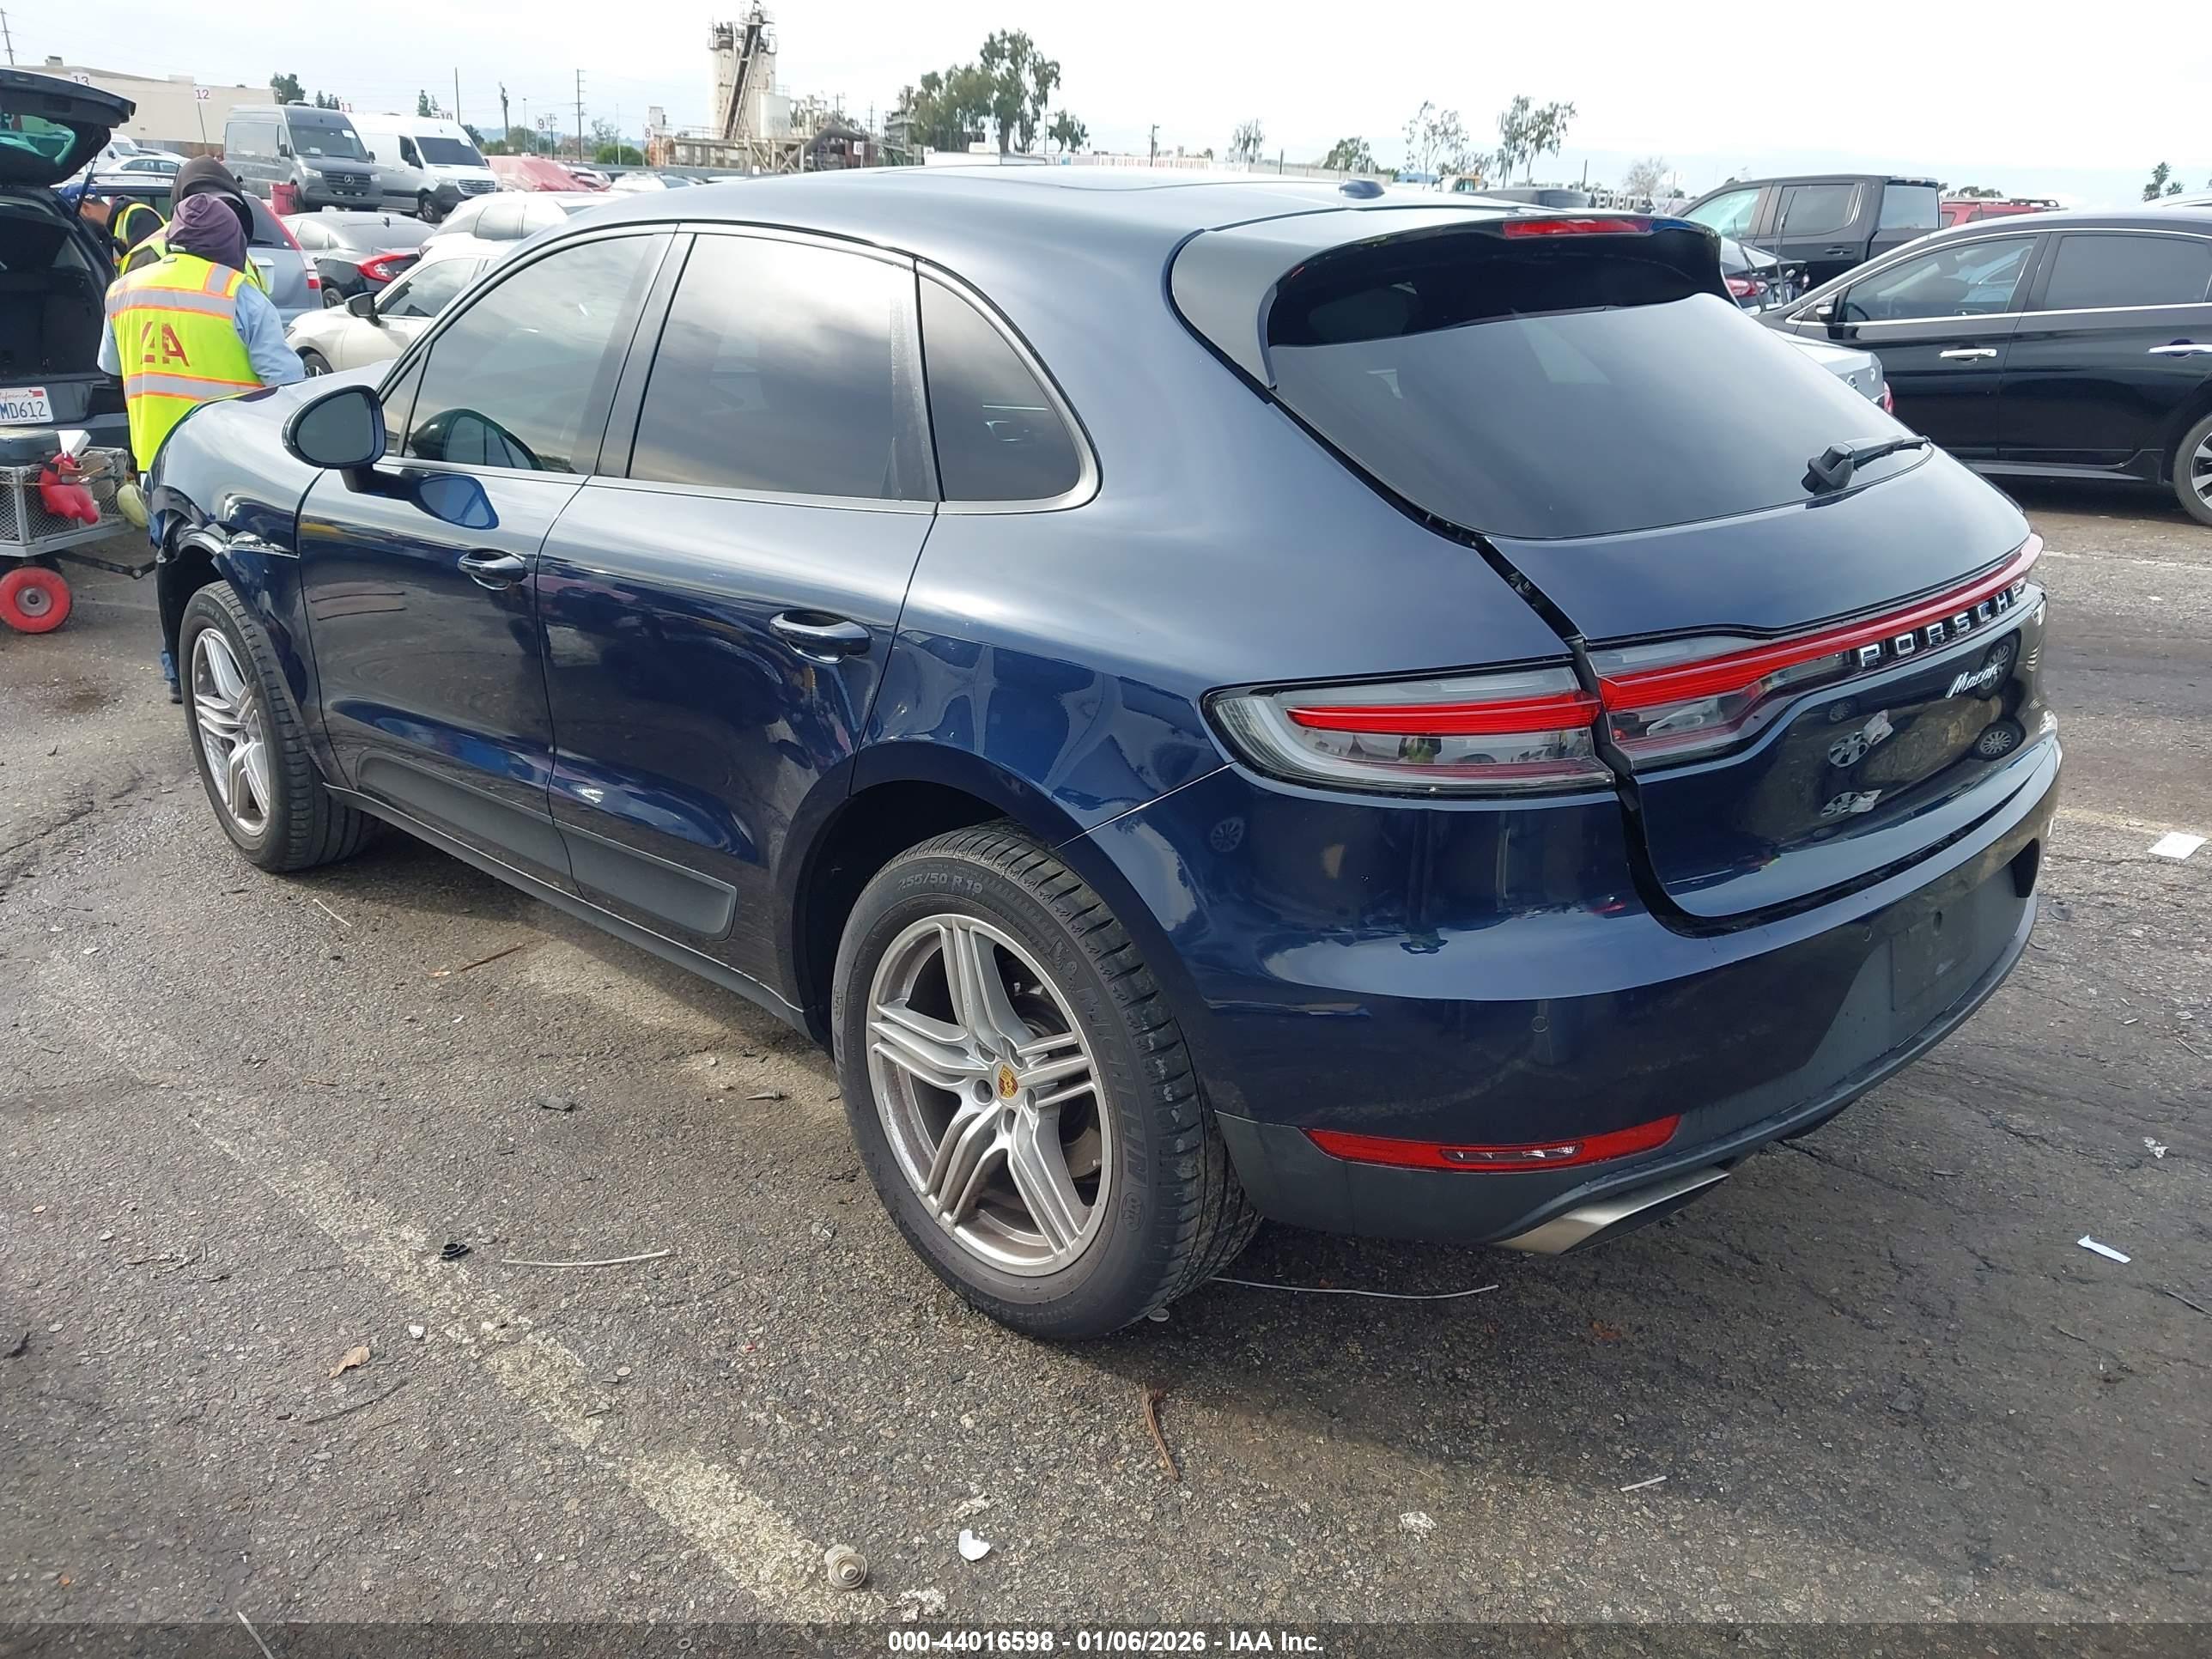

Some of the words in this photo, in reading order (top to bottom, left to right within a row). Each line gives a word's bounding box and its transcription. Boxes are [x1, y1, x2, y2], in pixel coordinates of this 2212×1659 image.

[195, 89, 210, 100] 12
[341, 103, 353, 112] 11
[538, 118, 544, 129] 9
[645, 128, 651, 138] 8
[1858, 577, 2027, 668] PORSCHE
[1944, 662, 2000, 700] Macan
[898, 872, 948, 891] 255/50
